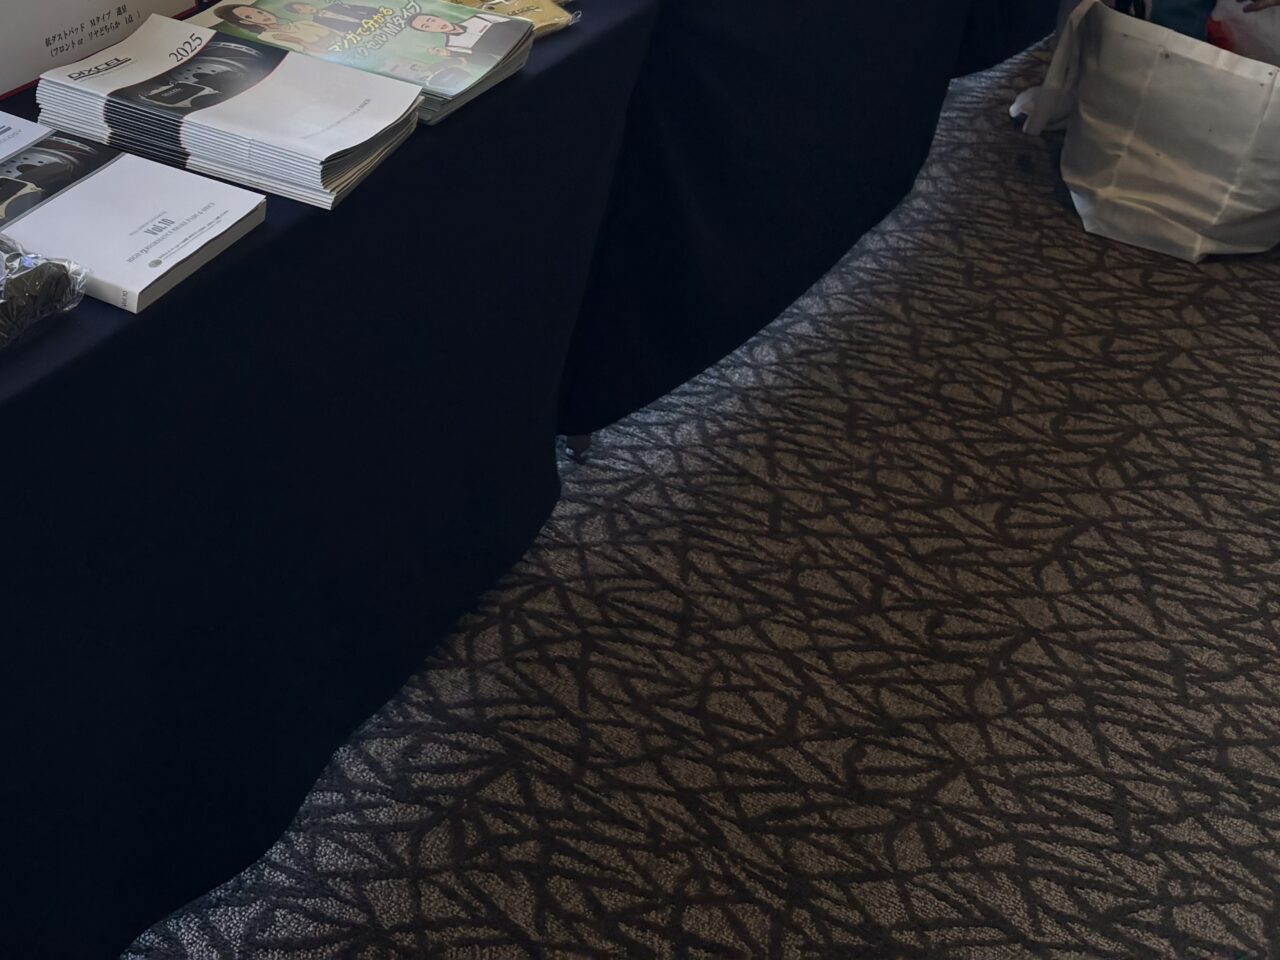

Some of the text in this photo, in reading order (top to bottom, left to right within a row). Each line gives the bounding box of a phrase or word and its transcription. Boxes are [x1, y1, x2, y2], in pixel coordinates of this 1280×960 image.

[327, 7, 393, 52] マンガで分かる
[168, 32, 203, 62] 2025
[67, 57, 132, 81] DIXCEL
